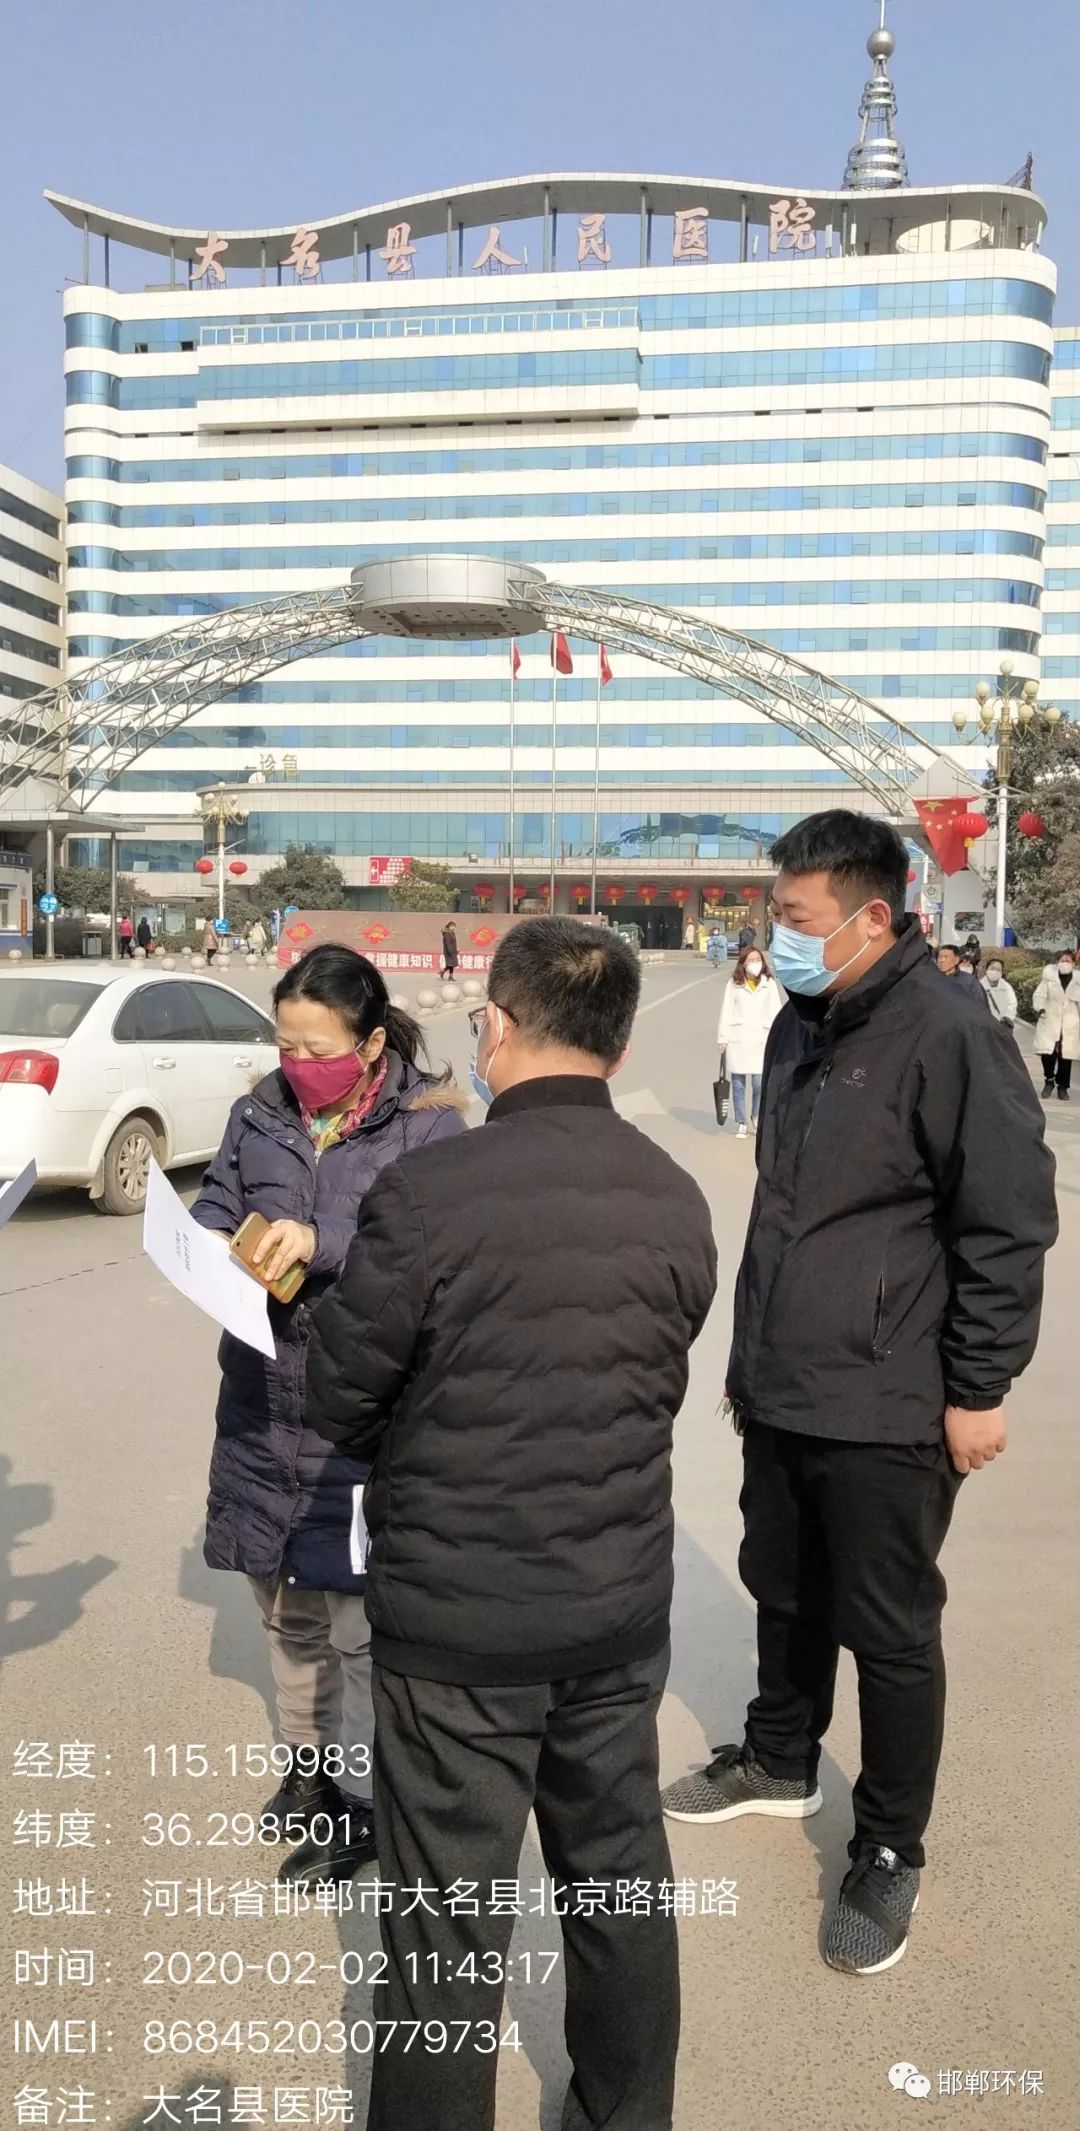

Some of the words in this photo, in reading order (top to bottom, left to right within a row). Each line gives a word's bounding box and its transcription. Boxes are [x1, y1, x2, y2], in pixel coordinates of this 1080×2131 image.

[190, 197, 816, 284] 大名县人民医院
